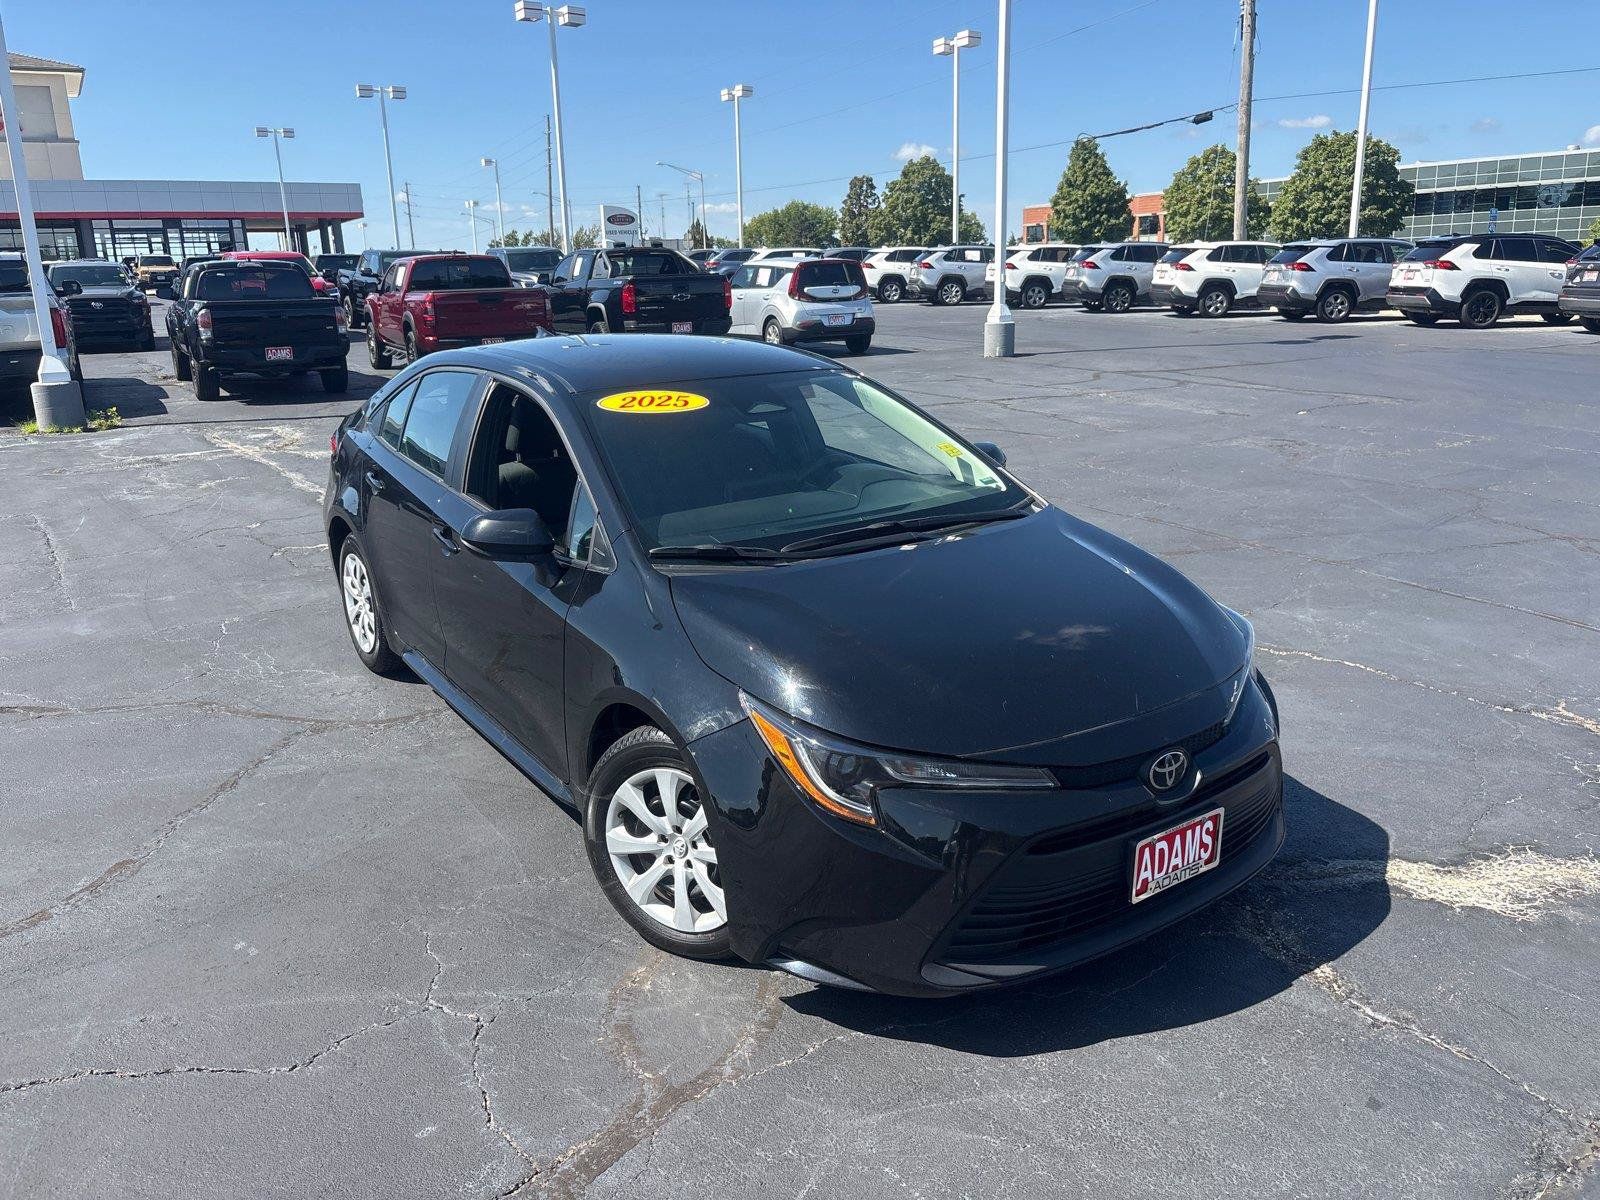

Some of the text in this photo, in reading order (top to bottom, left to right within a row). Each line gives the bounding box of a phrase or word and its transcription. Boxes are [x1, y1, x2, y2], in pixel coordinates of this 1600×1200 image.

[674, 325, 690, 333] ADAMS
[267, 349, 291, 359] ADAMS
[620, 395, 690, 408] 2025
[1136, 820, 1214, 891] ADAMS
